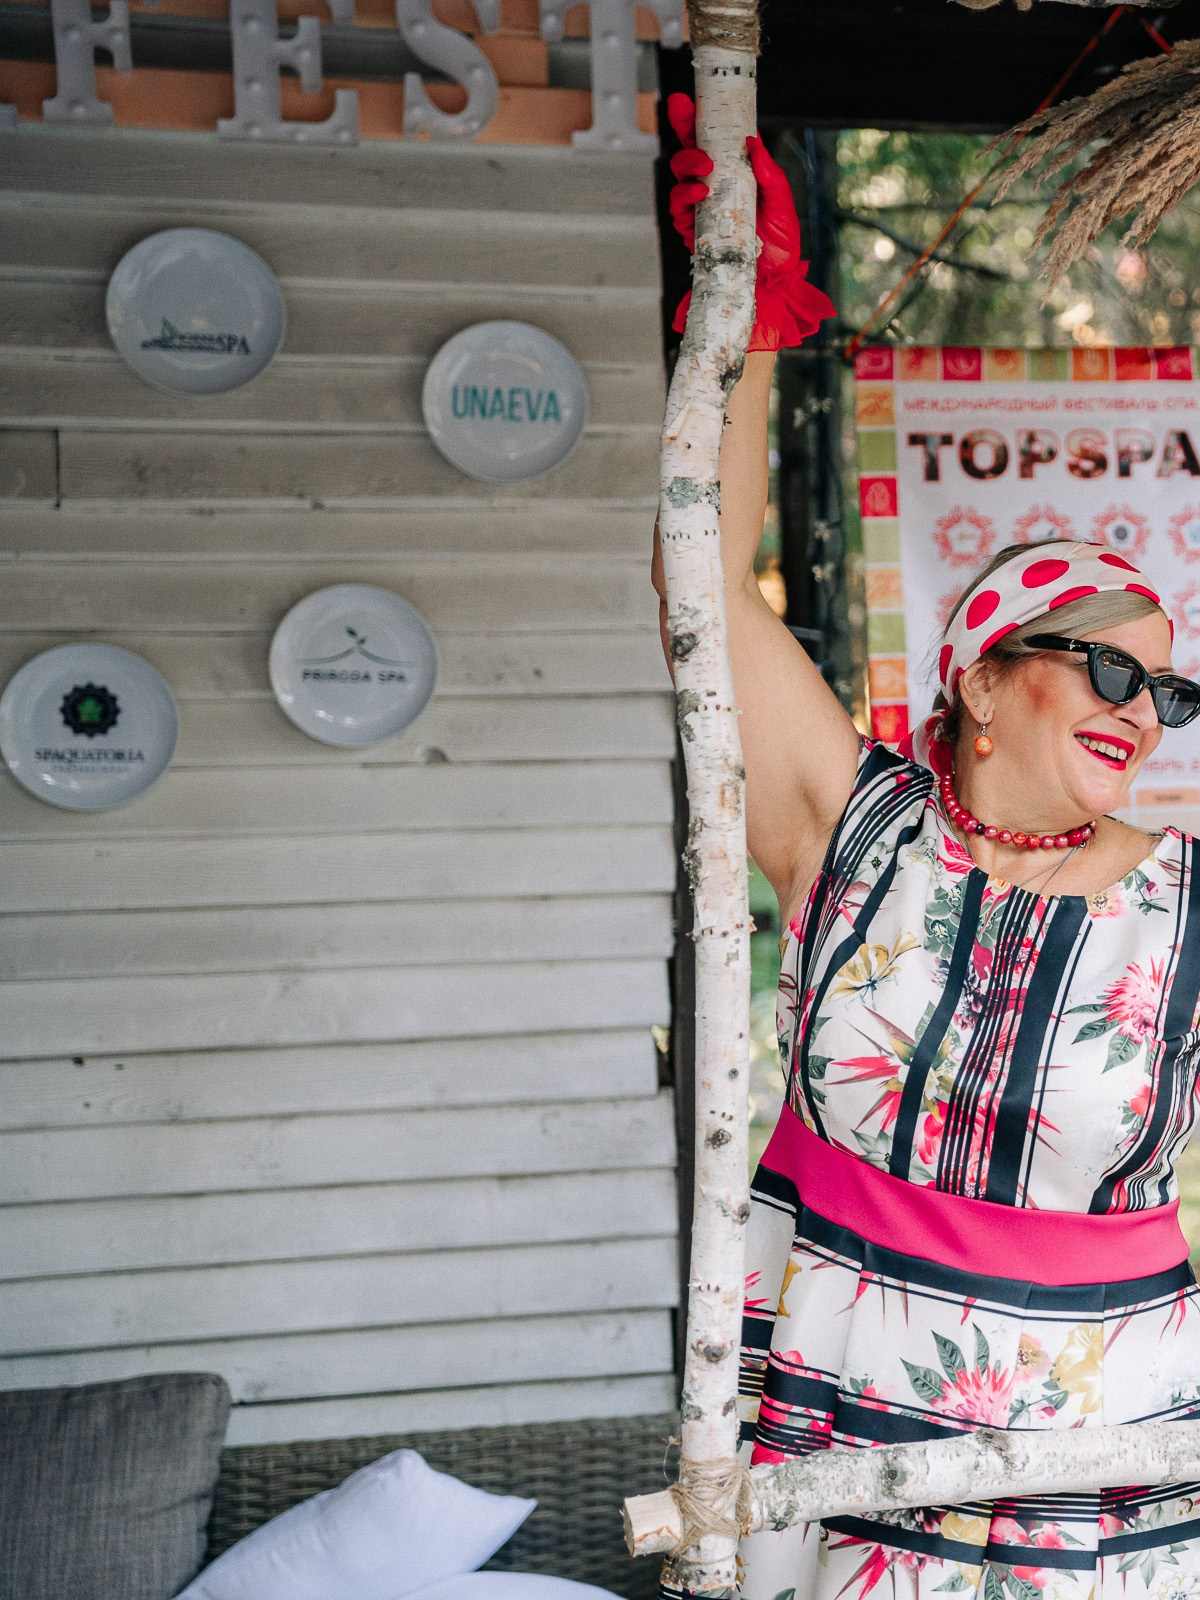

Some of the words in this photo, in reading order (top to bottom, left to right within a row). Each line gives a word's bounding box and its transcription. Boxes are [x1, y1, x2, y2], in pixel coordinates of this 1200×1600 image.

[451, 384, 562, 424] UNAEVA
[378, 669, 407, 684] SPA
[34, 747, 145, 763] SPAQUATORIA
